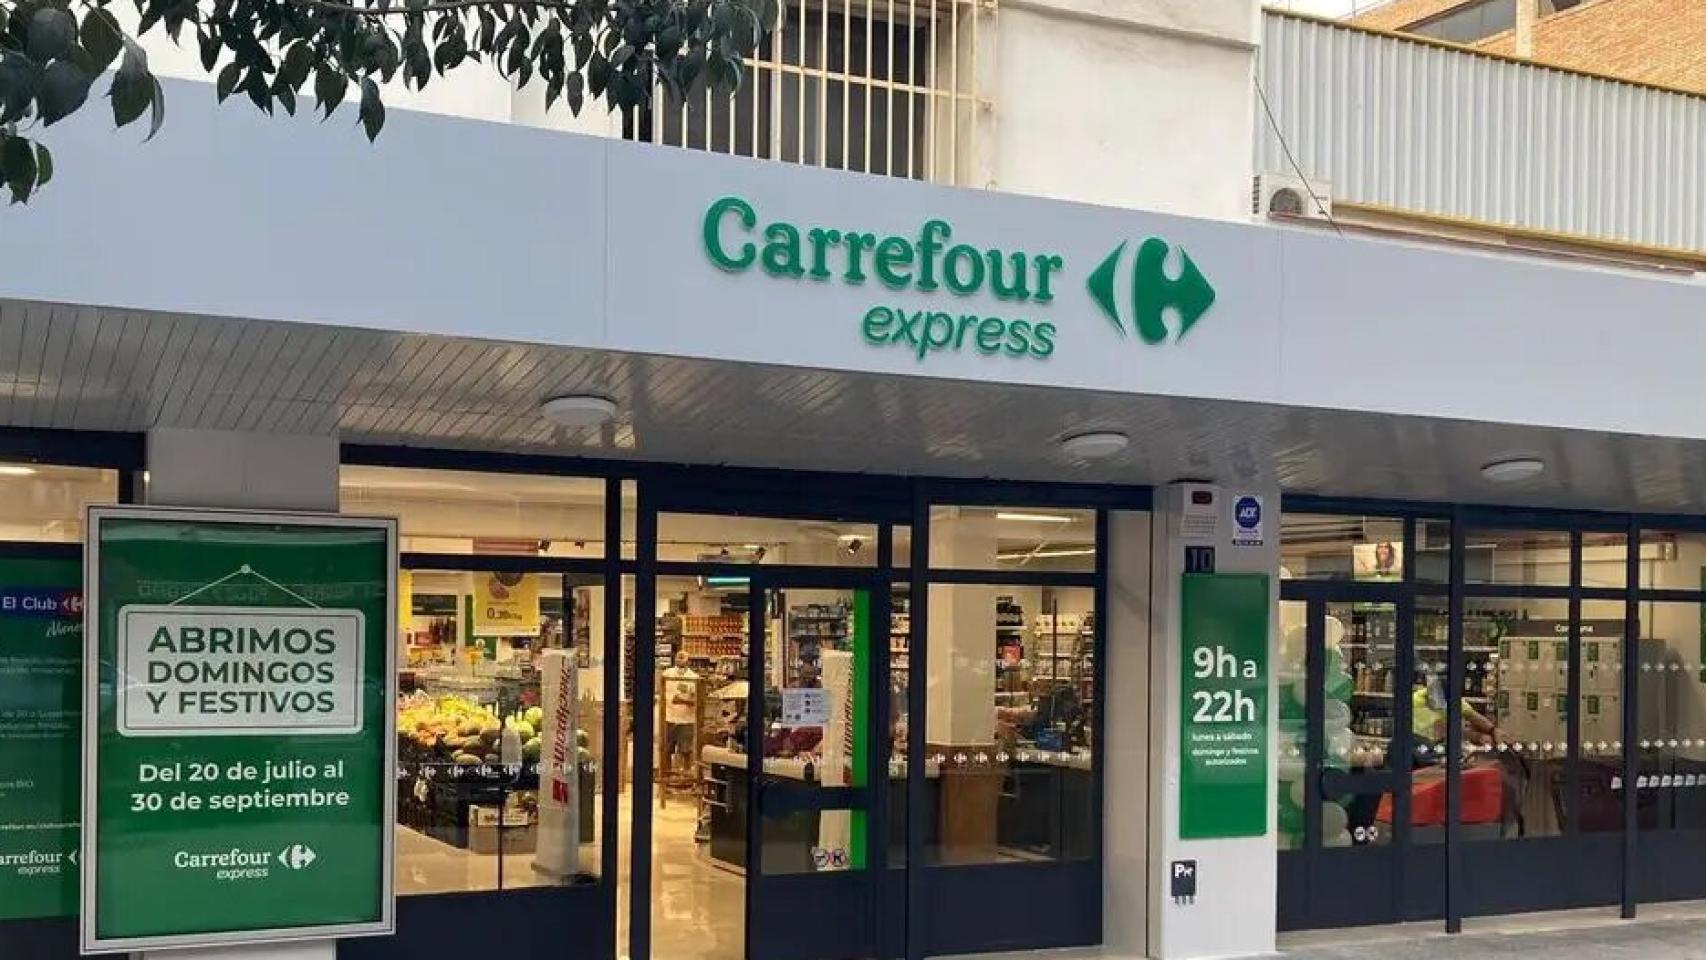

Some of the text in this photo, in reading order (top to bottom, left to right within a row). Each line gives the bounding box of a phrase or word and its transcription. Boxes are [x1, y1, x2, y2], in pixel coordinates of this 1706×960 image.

[703, 197, 1063, 302] Carrefour
[863, 305, 1056, 361] express
[3, 596, 58, 610] El Club
[147, 626, 336, 655] ABRIMOS
[148, 660, 335, 684] DOMINGOS
[1193, 645, 1258, 678] 9h a
[146, 691, 335, 714] Y FESTIVOS
[1192, 689, 1255, 722] 22h
[139, 760, 344, 783] Del 20 de julio al
[131, 788, 350, 812] 30 de septiembre
[0, 850, 63, 865] arrefour
[174, 848, 271, 868] Carrefour
[216, 868, 269, 880] express
